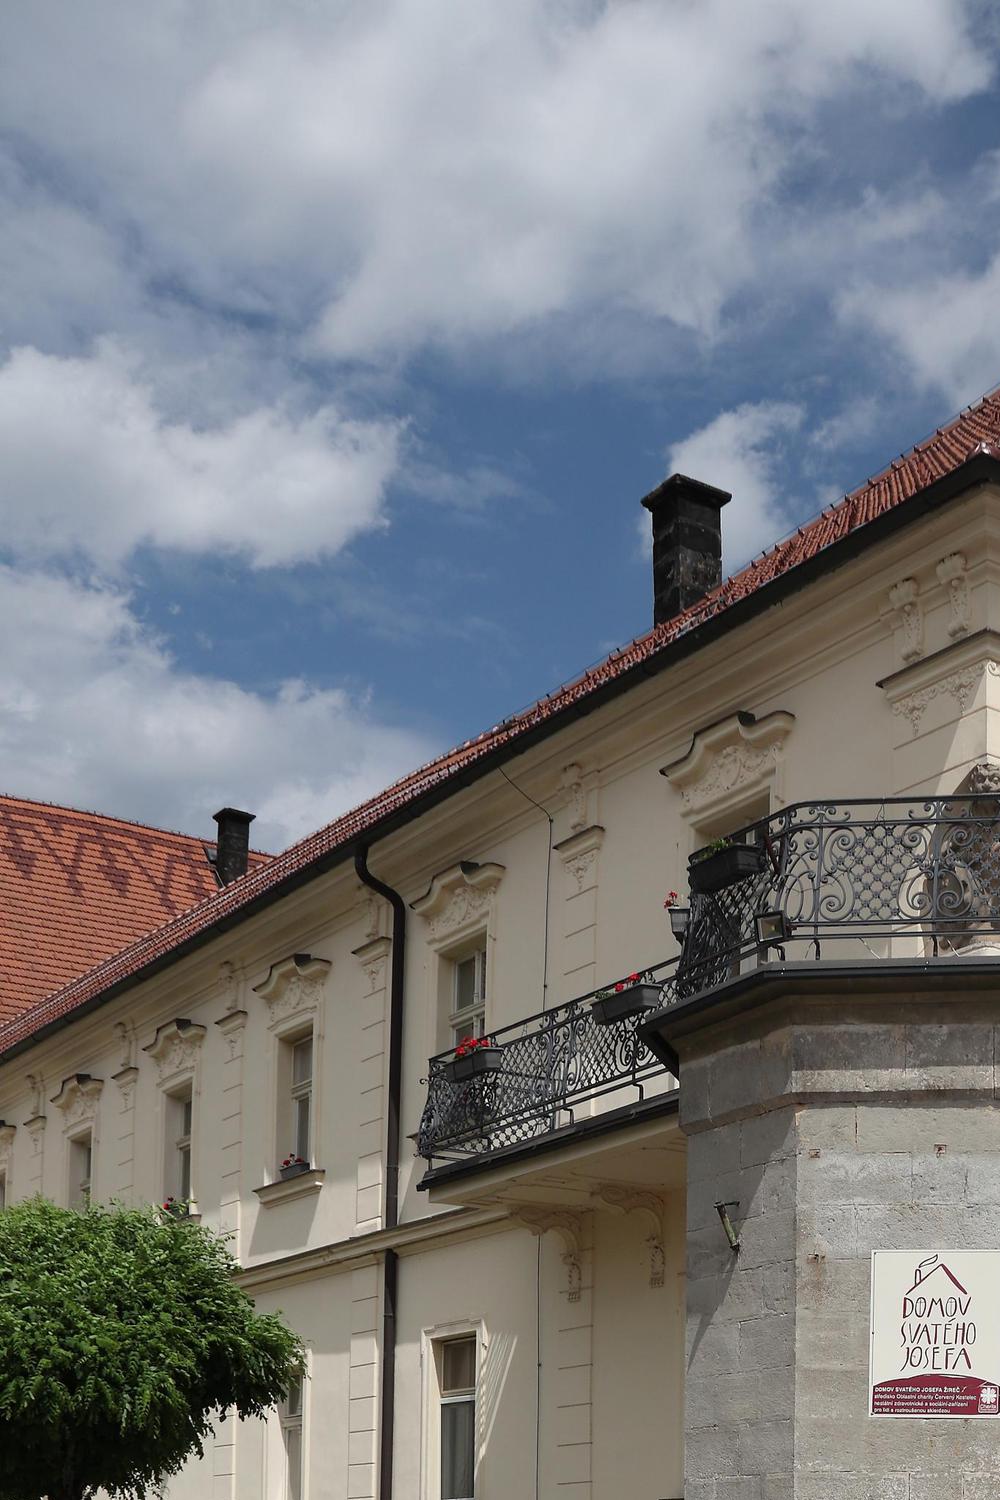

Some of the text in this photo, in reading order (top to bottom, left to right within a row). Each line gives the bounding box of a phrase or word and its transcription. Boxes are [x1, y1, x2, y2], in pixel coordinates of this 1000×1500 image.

[903, 1296, 972, 1319] DOMOV
[900, 1317, 976, 1347] SVATÉHO
[900, 1346, 972, 1372] JOSEFA
